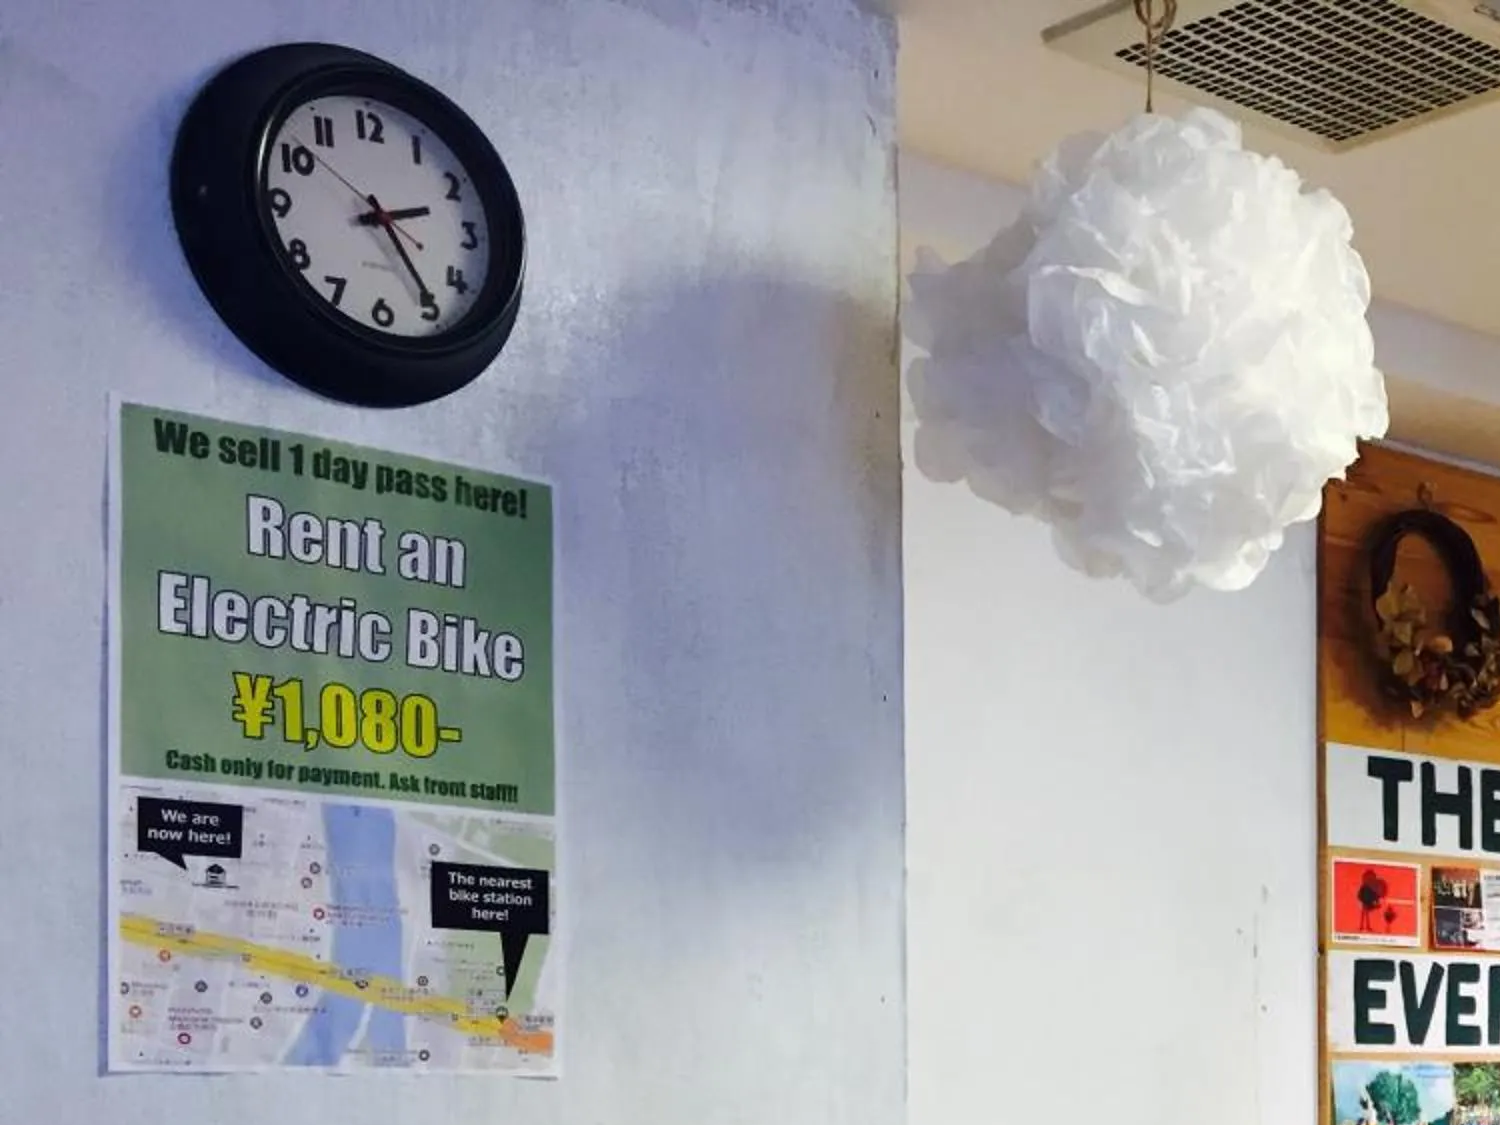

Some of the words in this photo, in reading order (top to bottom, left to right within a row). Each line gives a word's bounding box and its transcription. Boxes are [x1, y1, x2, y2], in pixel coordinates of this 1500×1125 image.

[313, 115, 335, 147] 11
[355, 110, 385, 143] 12
[281, 143, 315, 176] 10
[411, 135, 422, 164] 1
[443, 172, 461, 201] 2
[271, 187, 292, 217] 9
[460, 222, 478, 250] 3
[288, 238, 311, 270] 8
[324, 276, 346, 306] 7
[445, 266, 468, 294] 4
[371, 298, 394, 327] 6
[154, 418, 210, 459] We
[218, 437, 281, 473] sell
[288, 446, 304, 476] 1
[312, 448, 369, 491] day
[375, 466, 449, 503] pass
[454, 475, 528, 519] here!
[246, 494, 386, 575] Rent
[397, 530, 466, 588] an
[157, 570, 393, 662] Electric
[406, 608, 525, 682] Bike
[232, 671, 463, 758] ¥1,080-
[166, 749, 216, 774] Cash
[220, 757, 264, 780] only
[266, 760, 295, 782] for
[298, 764, 386, 790] payment.
[389, 772, 420, 794] Ask
[423, 775, 467, 799] front
[160, 808, 188, 825] We
[191, 812, 220, 827] are
[147, 827, 184, 842] now
[187, 828, 232, 845] here!
[447, 871, 476, 886] The
[479, 876, 534, 890] nearest
[448, 888, 480, 903] bike
[482, 892, 533, 907] station
[471, 906, 510, 922] here!
